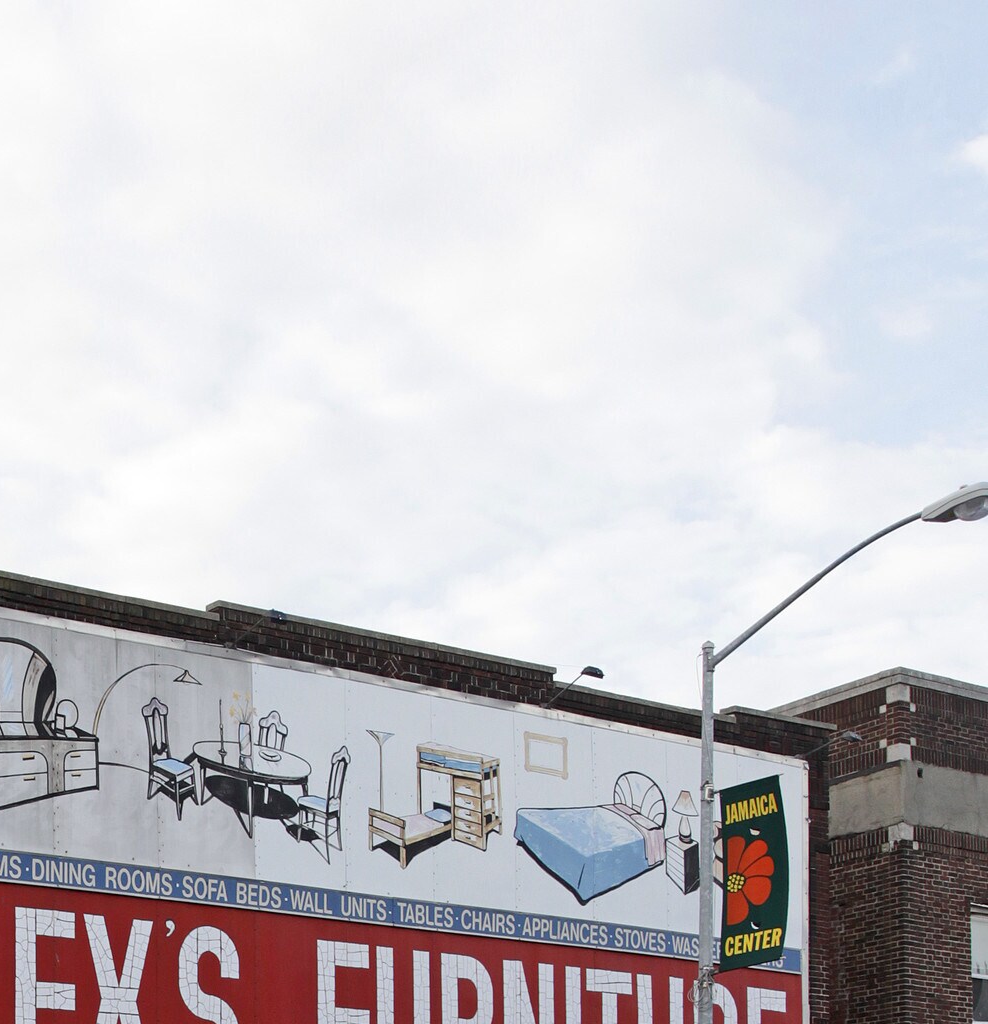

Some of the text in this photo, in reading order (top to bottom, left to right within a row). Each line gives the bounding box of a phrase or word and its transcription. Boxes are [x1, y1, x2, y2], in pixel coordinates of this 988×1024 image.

[725, 793, 778, 825] JAMAICA
[32, 858, 96, 886] DINING
[105, 866, 173, 896] ROOMS
[182, 876, 228, 901] SOFA
[237, 883, 281, 908] BEDS
[290, 889, 332, 914] WALL
[341, 896, 387, 921] UNITS
[398, 903, 453, 928] TABLES
[461, 909, 515, 935] CHAIRS
[522, 918, 608, 945] APPLIANCES
[615, 928, 665, 952] STOVES
[725, 927, 782, 957] CENTER
